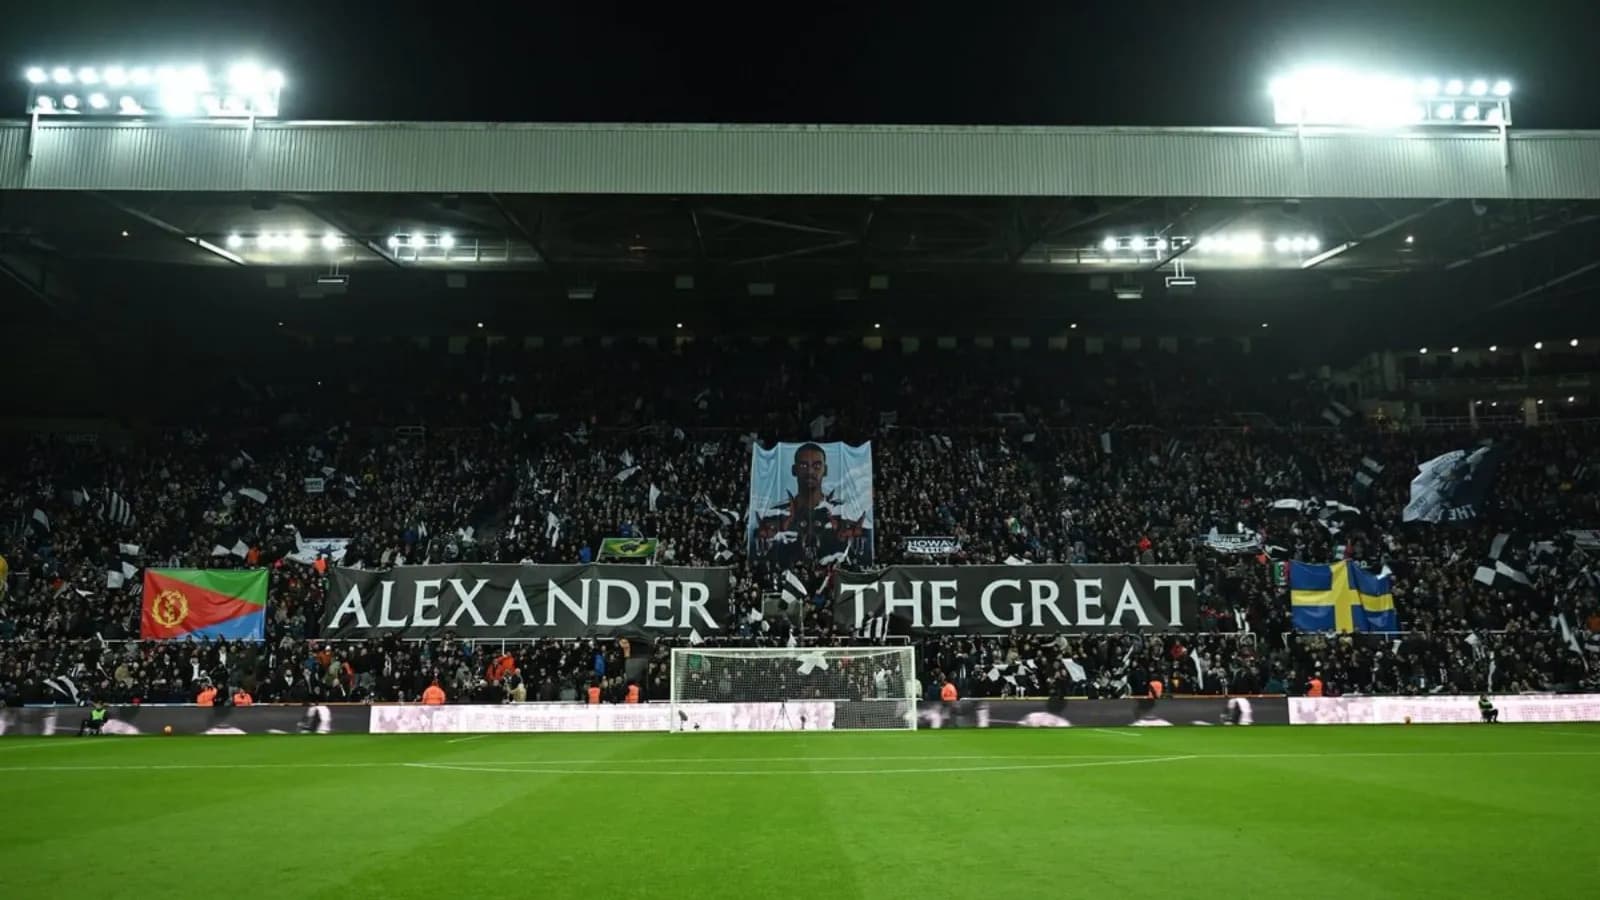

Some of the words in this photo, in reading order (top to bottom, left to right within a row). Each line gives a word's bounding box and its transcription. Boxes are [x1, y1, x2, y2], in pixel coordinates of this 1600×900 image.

[328, 579, 719, 629] ALEXANDER
[840, 580, 960, 629] THE
[981, 579, 1195, 627] GREAT
